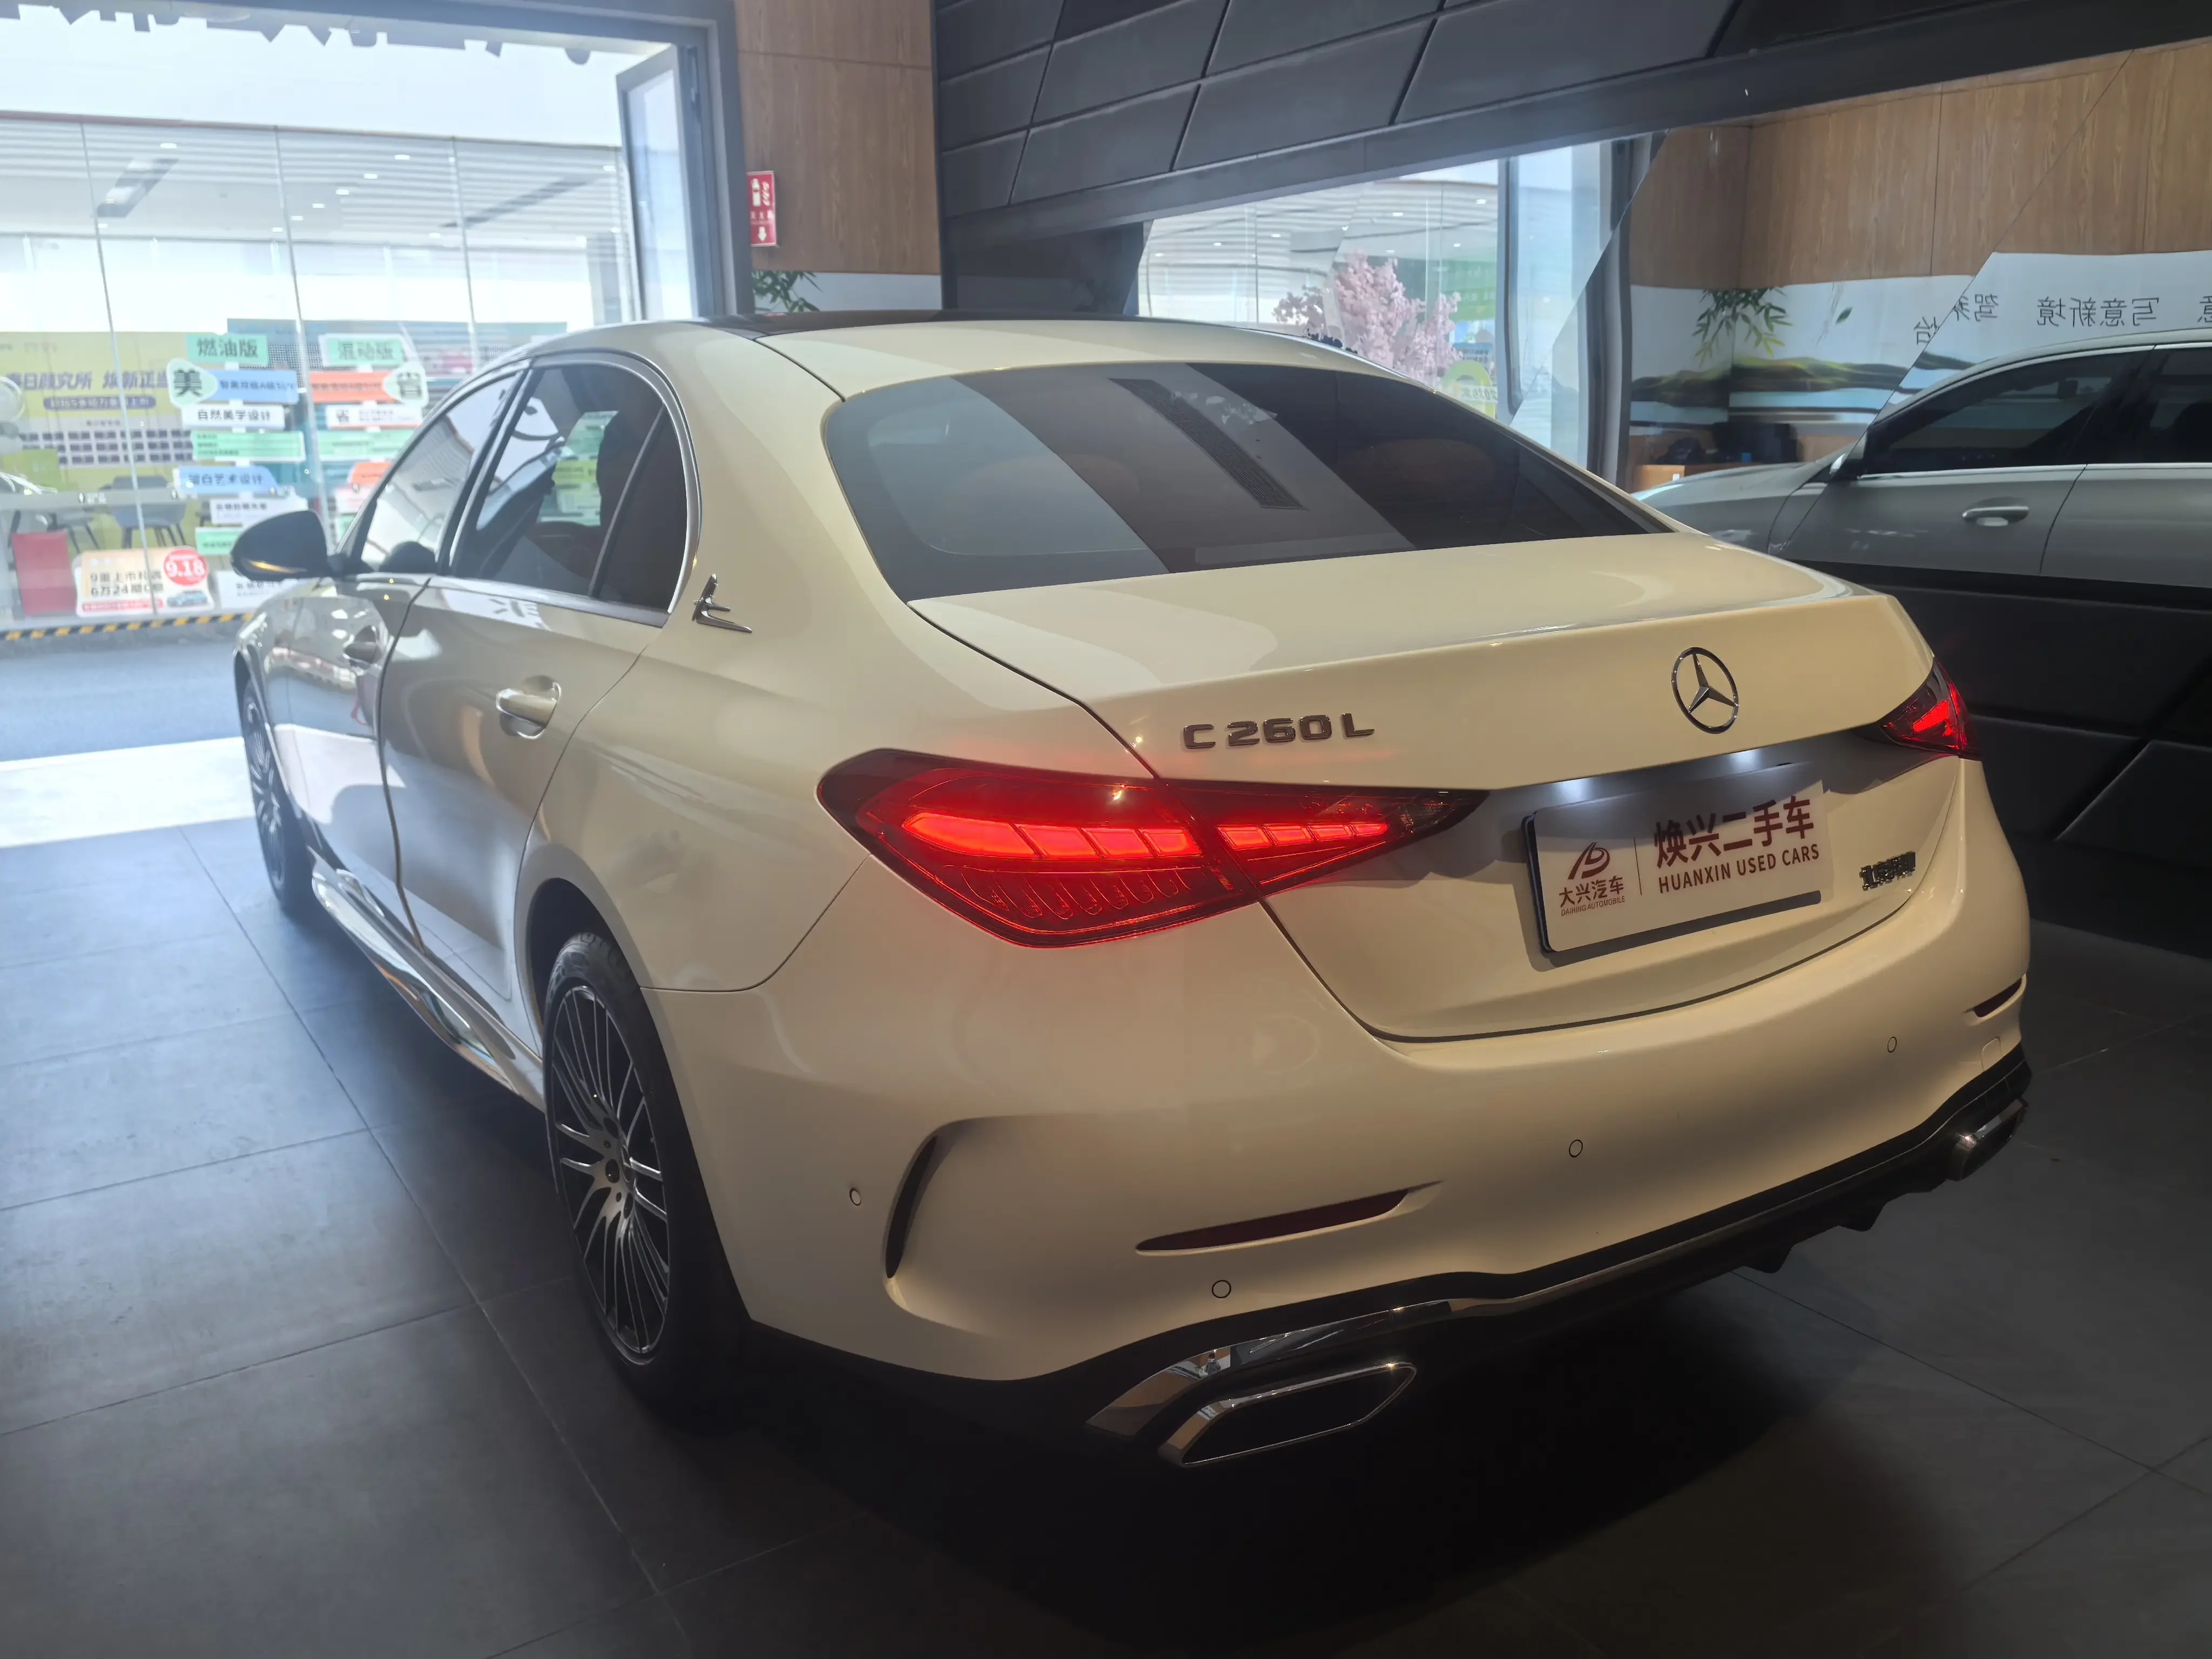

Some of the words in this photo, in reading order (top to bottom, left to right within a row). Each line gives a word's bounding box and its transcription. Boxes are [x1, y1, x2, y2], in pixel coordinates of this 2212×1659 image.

[197, 338, 258, 358] 燃油版
[173, 368, 203, 397] 美
[198, 410, 270, 421] 自然美学设计
[166, 560, 205, 578] 9.18
[1184, 724, 1216, 749] C
[1654, 795, 1815, 868] 焕兴二手车
[1658, 862, 1732, 894] HUANXIN
[1736, 853, 1776, 876] USED
[1782, 844, 1820, 866] CARS
[1559, 875, 1624, 908] 大兴汽车
[1588, 895, 1626, 911] AUTOMOBILE
